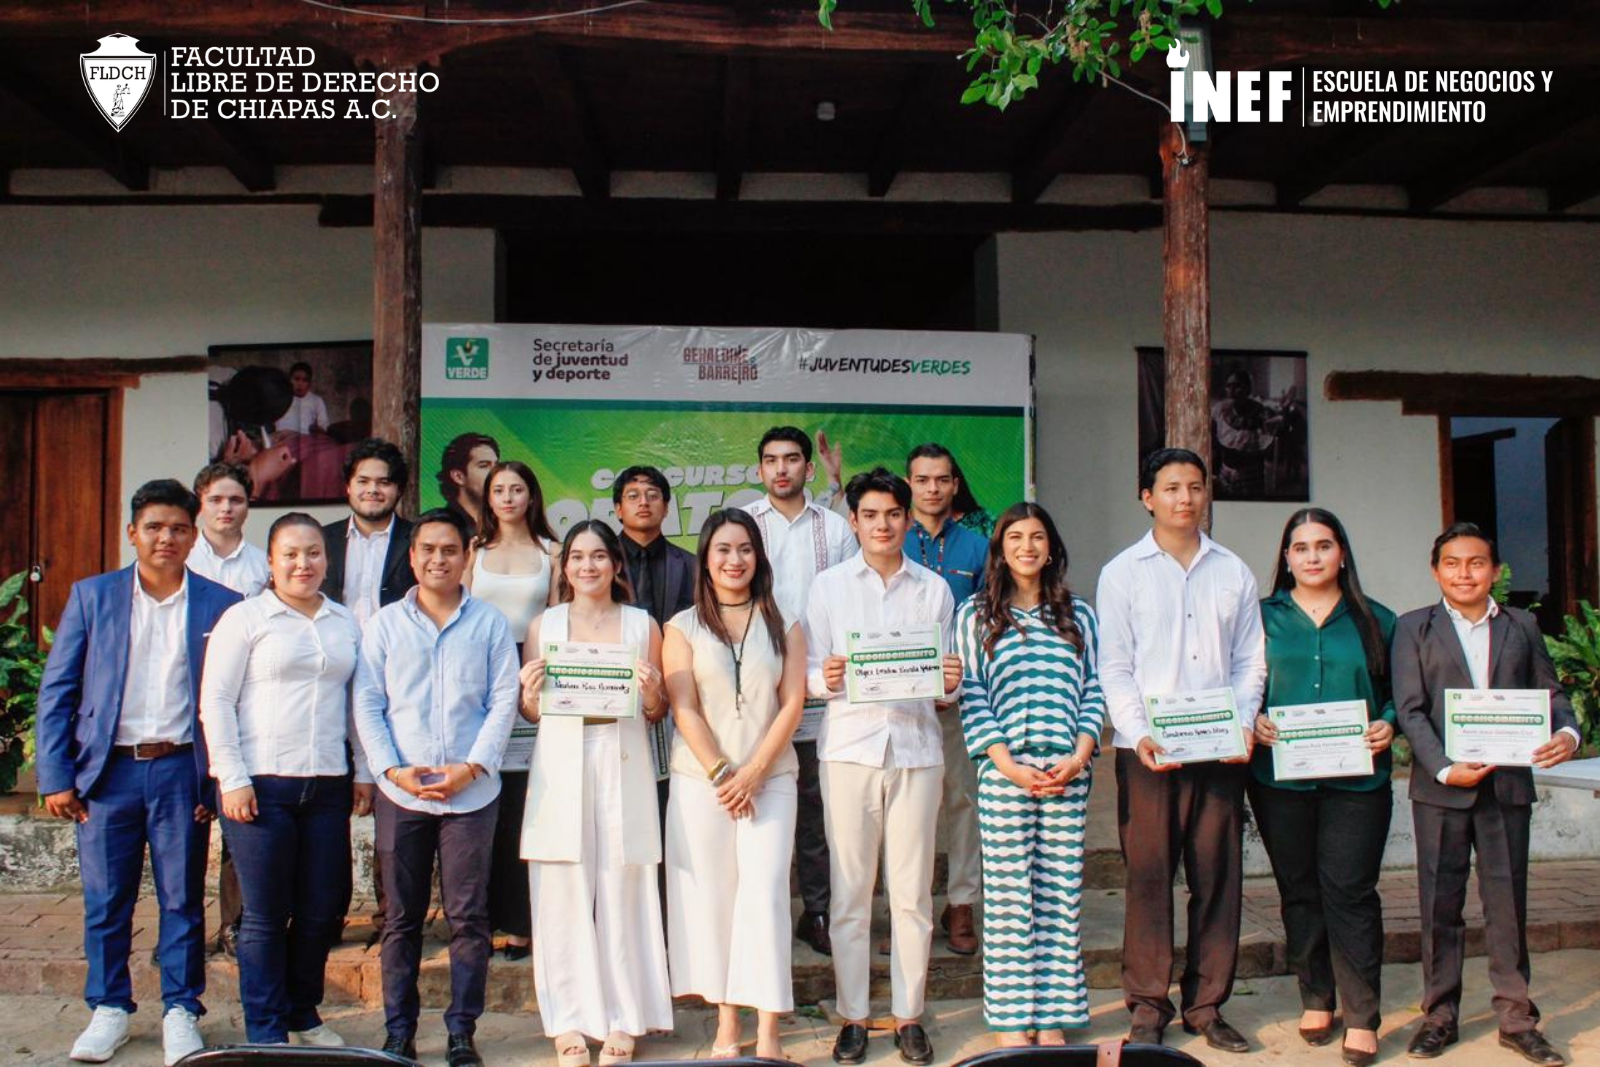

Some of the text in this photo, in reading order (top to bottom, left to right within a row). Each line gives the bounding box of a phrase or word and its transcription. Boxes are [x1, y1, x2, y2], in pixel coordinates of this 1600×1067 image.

[533, 339, 614, 352] Secretaría
[533, 353, 629, 367] de juventud
[447, 367, 487, 378] VERDE
[532, 367, 611, 382] y deporte
